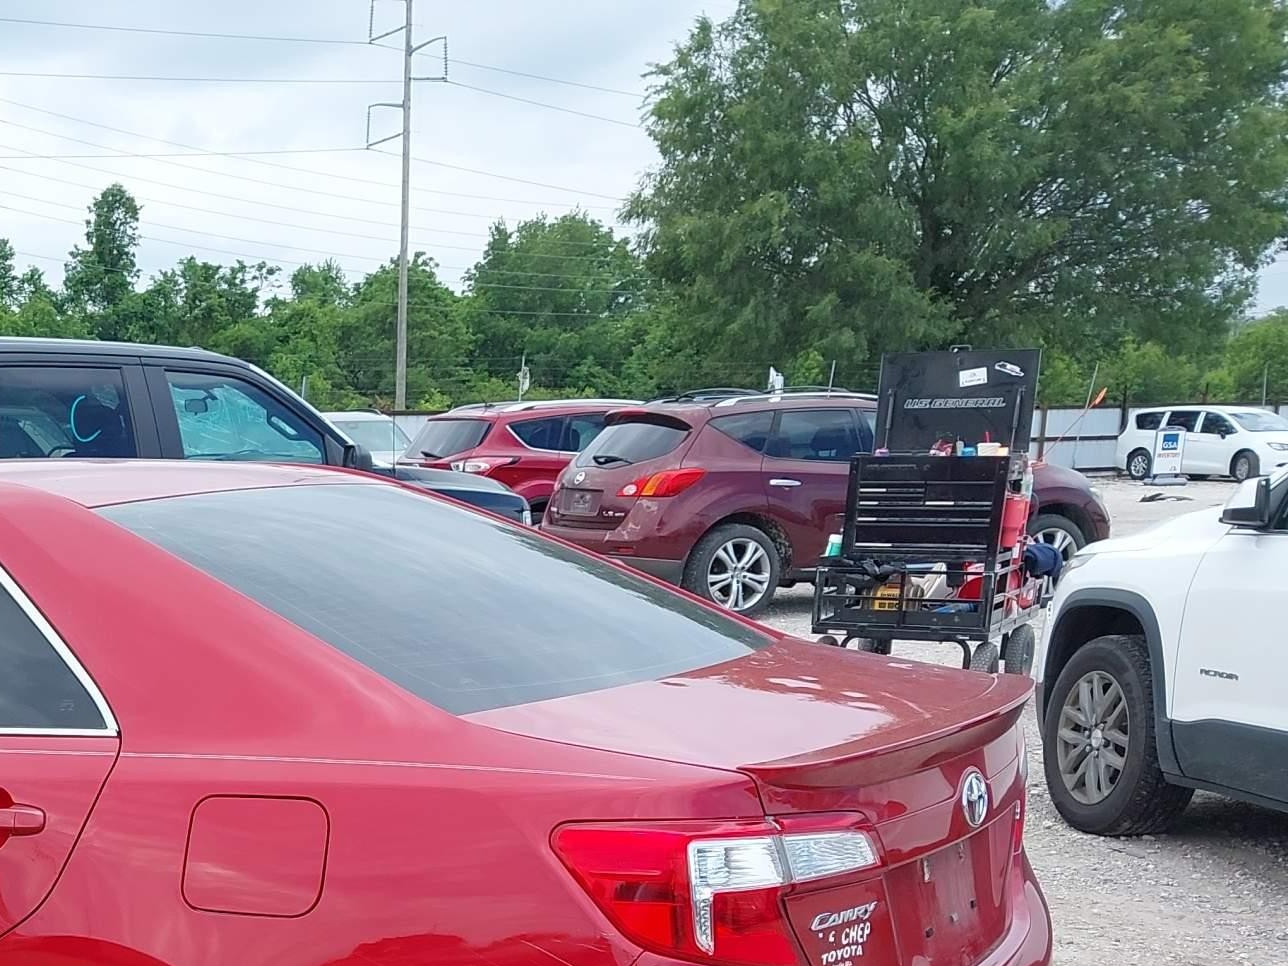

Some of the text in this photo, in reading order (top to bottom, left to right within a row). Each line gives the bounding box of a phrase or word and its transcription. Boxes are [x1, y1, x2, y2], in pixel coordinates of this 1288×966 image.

[931, 397, 1006, 408] GENERAL
[70, 395, 102, 442] C
[1163, 441, 1178, 449] GSA
[1200, 668, 1239, 681] ACADIA
[810, 901, 878, 931] CAMRY
[821, 944, 863, 966] TOYOTA
